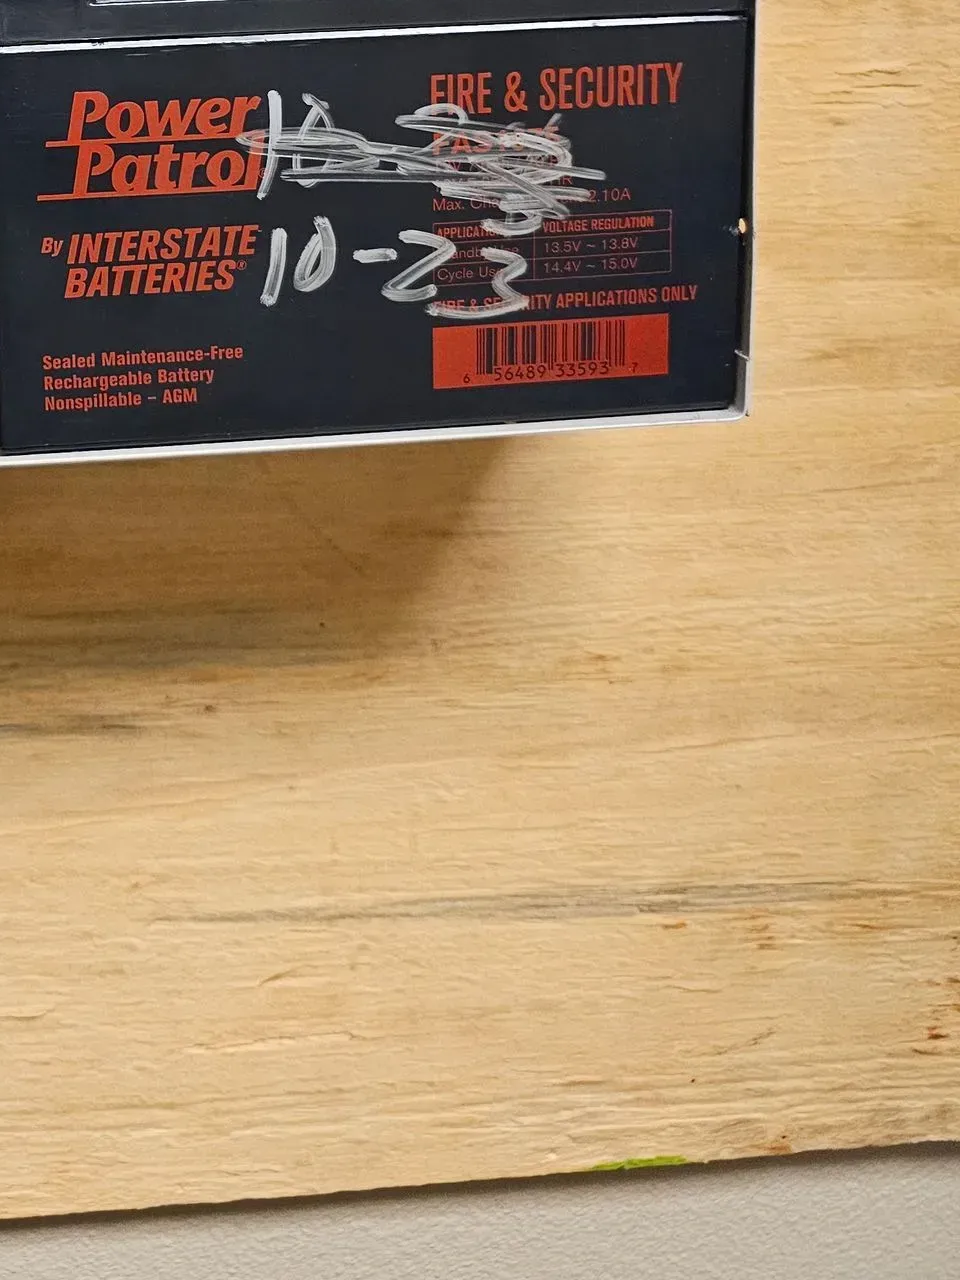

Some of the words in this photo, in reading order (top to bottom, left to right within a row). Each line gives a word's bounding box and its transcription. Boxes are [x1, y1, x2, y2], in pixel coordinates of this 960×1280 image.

[431, 72, 492, 116] FIRE
[504, 71, 528, 112] &
[540, 63, 683, 112] SECURITY
[67, 91, 262, 146] Power
[73, 139, 264, 196] Patrol
[433, 197, 465, 212] Max.
[543, 218, 588, 234] VOLTAGE
[591, 215, 655, 230] REGULATION
[41, 237, 64, 257] By
[67, 224, 259, 265] INTERSTATE
[544, 240, 582, 254] 13.5V
[602, 236, 639, 250] 13.8V
[259, 216, 528, 320] 10-23
[437, 265, 474, 282] Cycle
[478, 266, 504, 279] Us
[544, 260, 582, 274] 14.4V
[602, 257, 639, 271] 15.0V
[556, 286, 658, 309] APPLICATIONS
[661, 284, 699, 302] ONLY
[42, 351, 96, 370] Sealed
[101, 345, 244, 368] Maintenance-Free
[43, 370, 152, 392] Rechargeable
[158, 368, 215, 385] Battery
[463, 373, 471, 384] 6
[494, 364, 547, 381] 56489
[556, 361, 610, 379] 33593
[44, 392, 142, 412] Nonspillable
[162, 387, 198, 405] AGM
